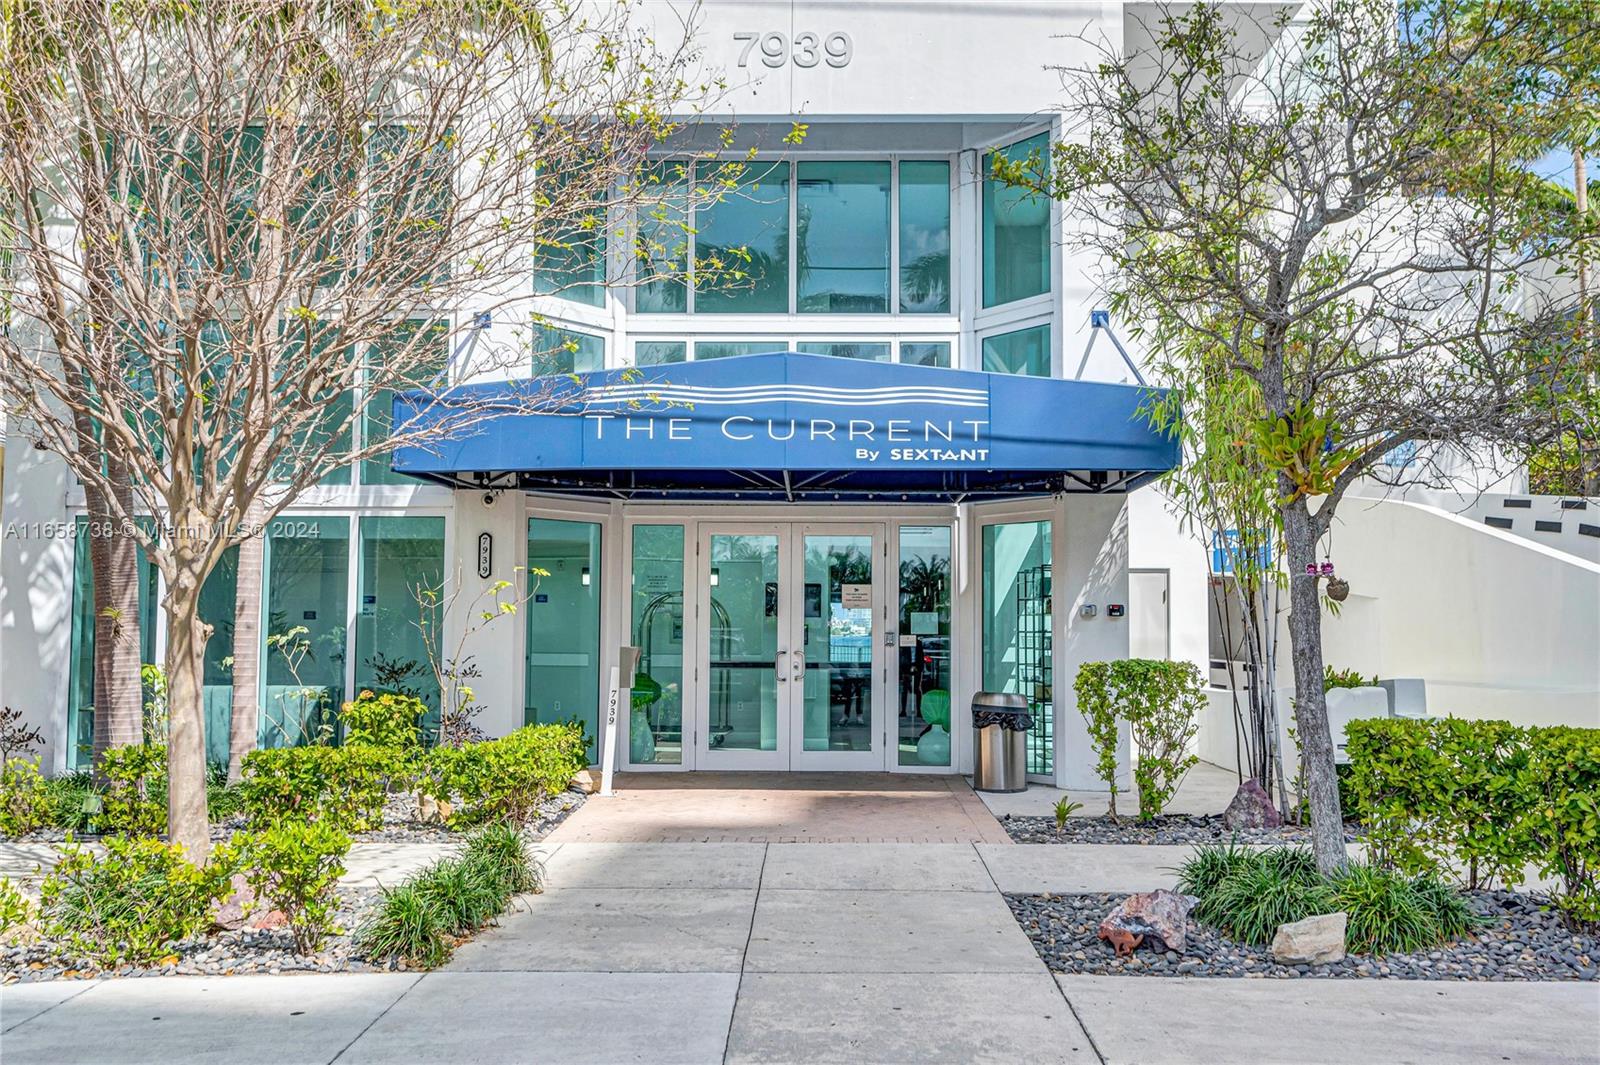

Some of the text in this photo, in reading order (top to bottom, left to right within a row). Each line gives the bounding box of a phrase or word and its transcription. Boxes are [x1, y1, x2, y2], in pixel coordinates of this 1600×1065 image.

[733, 31, 854, 69] 7939
[585, 415, 990, 442] THE CURRENT
[855, 448, 990, 462] By SEXTANT
[481, 536, 489, 575] 7939
[608, 689, 618, 725] 7939
